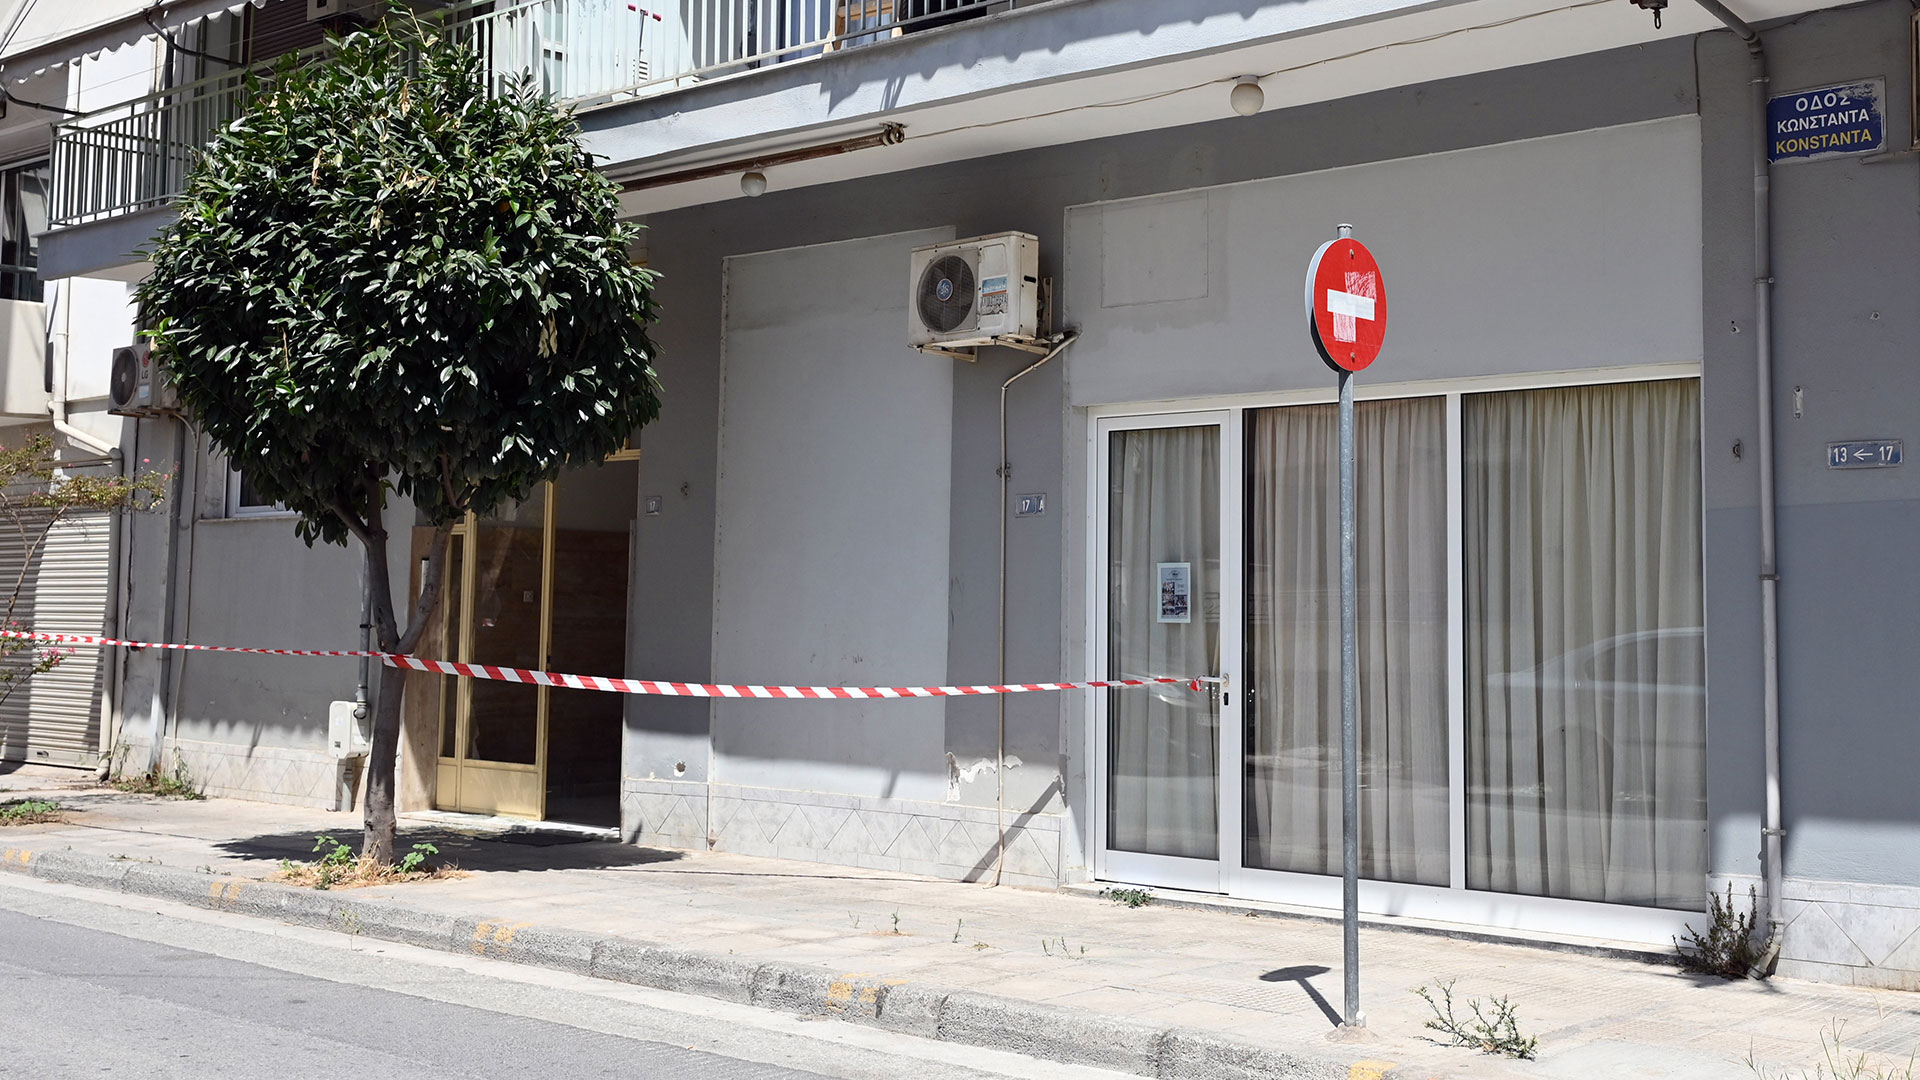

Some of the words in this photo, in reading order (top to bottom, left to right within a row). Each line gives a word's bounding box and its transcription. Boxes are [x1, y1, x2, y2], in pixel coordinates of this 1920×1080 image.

[1777, 108, 1869, 134] ΚΩΝΣΤΑΝΤΑ
[1776, 128, 1872, 154] KONSTANTA
[141, 370, 149, 379] LG
[1833, 447, 1847, 462] 13
[1879, 445, 1894, 461] 17
[1022, 499, 1031, 512] 17
